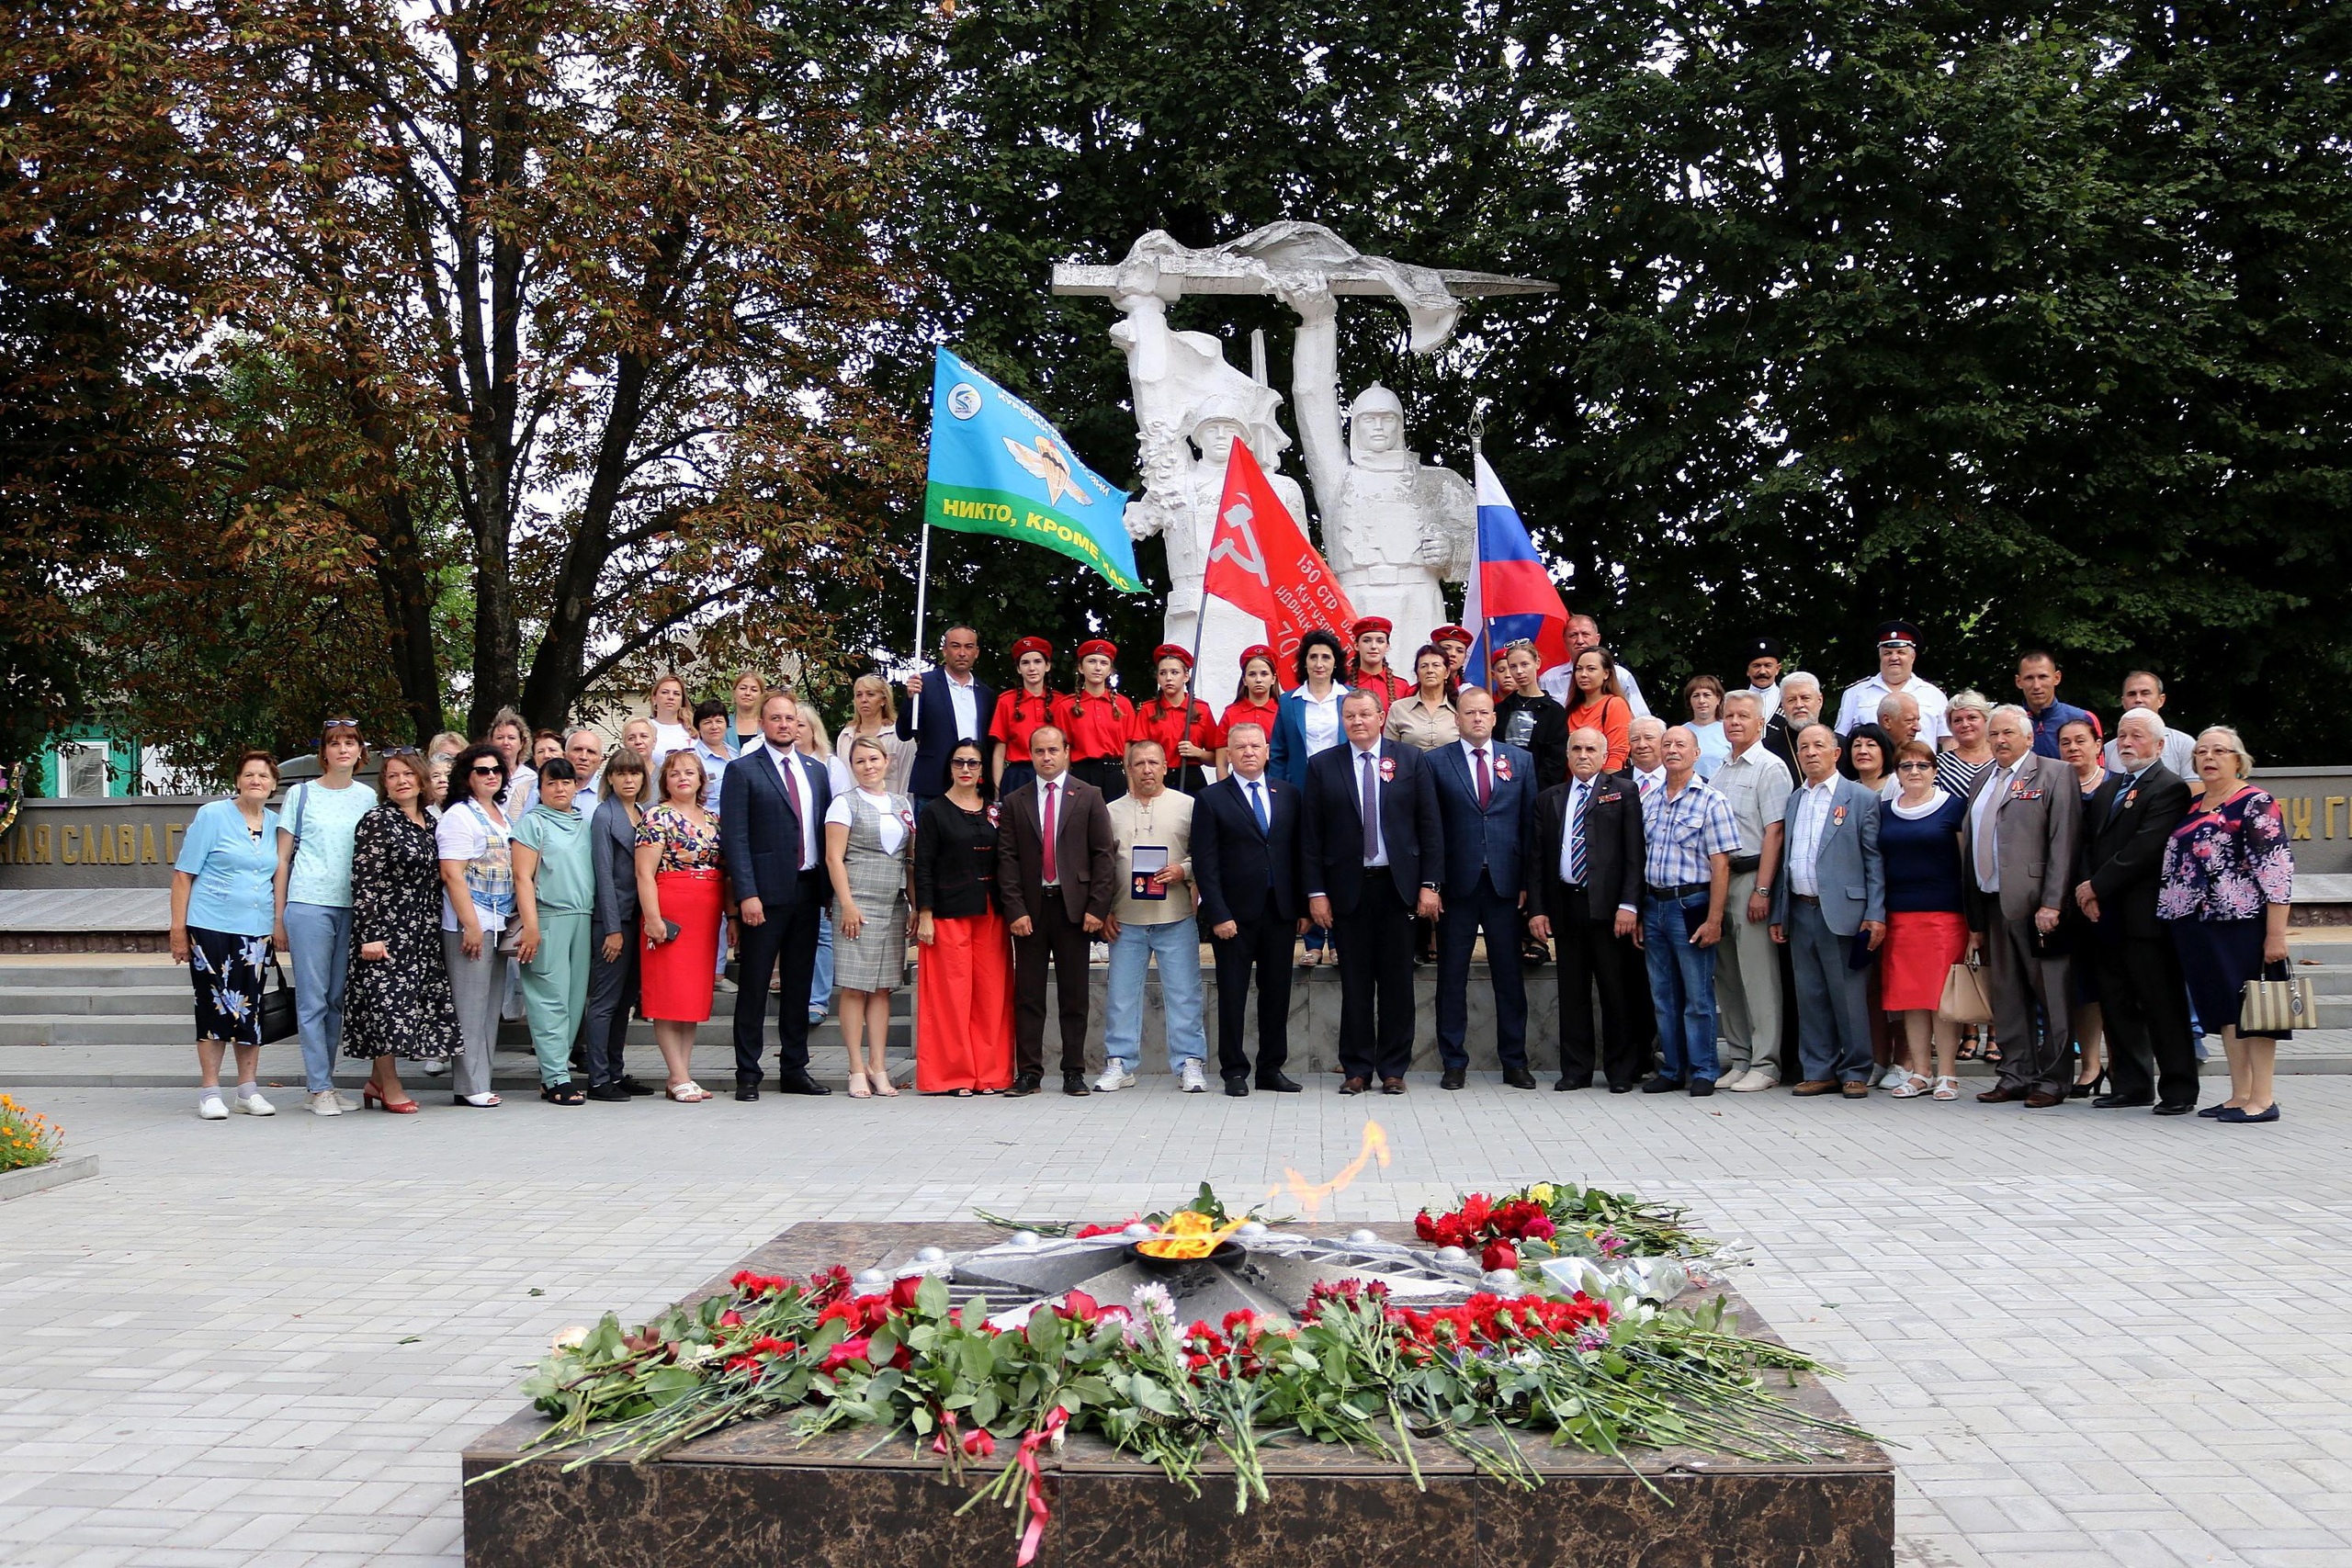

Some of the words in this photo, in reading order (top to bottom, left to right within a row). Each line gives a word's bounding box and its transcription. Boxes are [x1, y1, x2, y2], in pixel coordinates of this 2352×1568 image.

[943, 498, 1017, 527] НИКТО,
[1025, 512, 1100, 561] КРОМЕ
[1296, 554, 1321, 583] 150
[61, 823, 158, 865] СЛАВА
